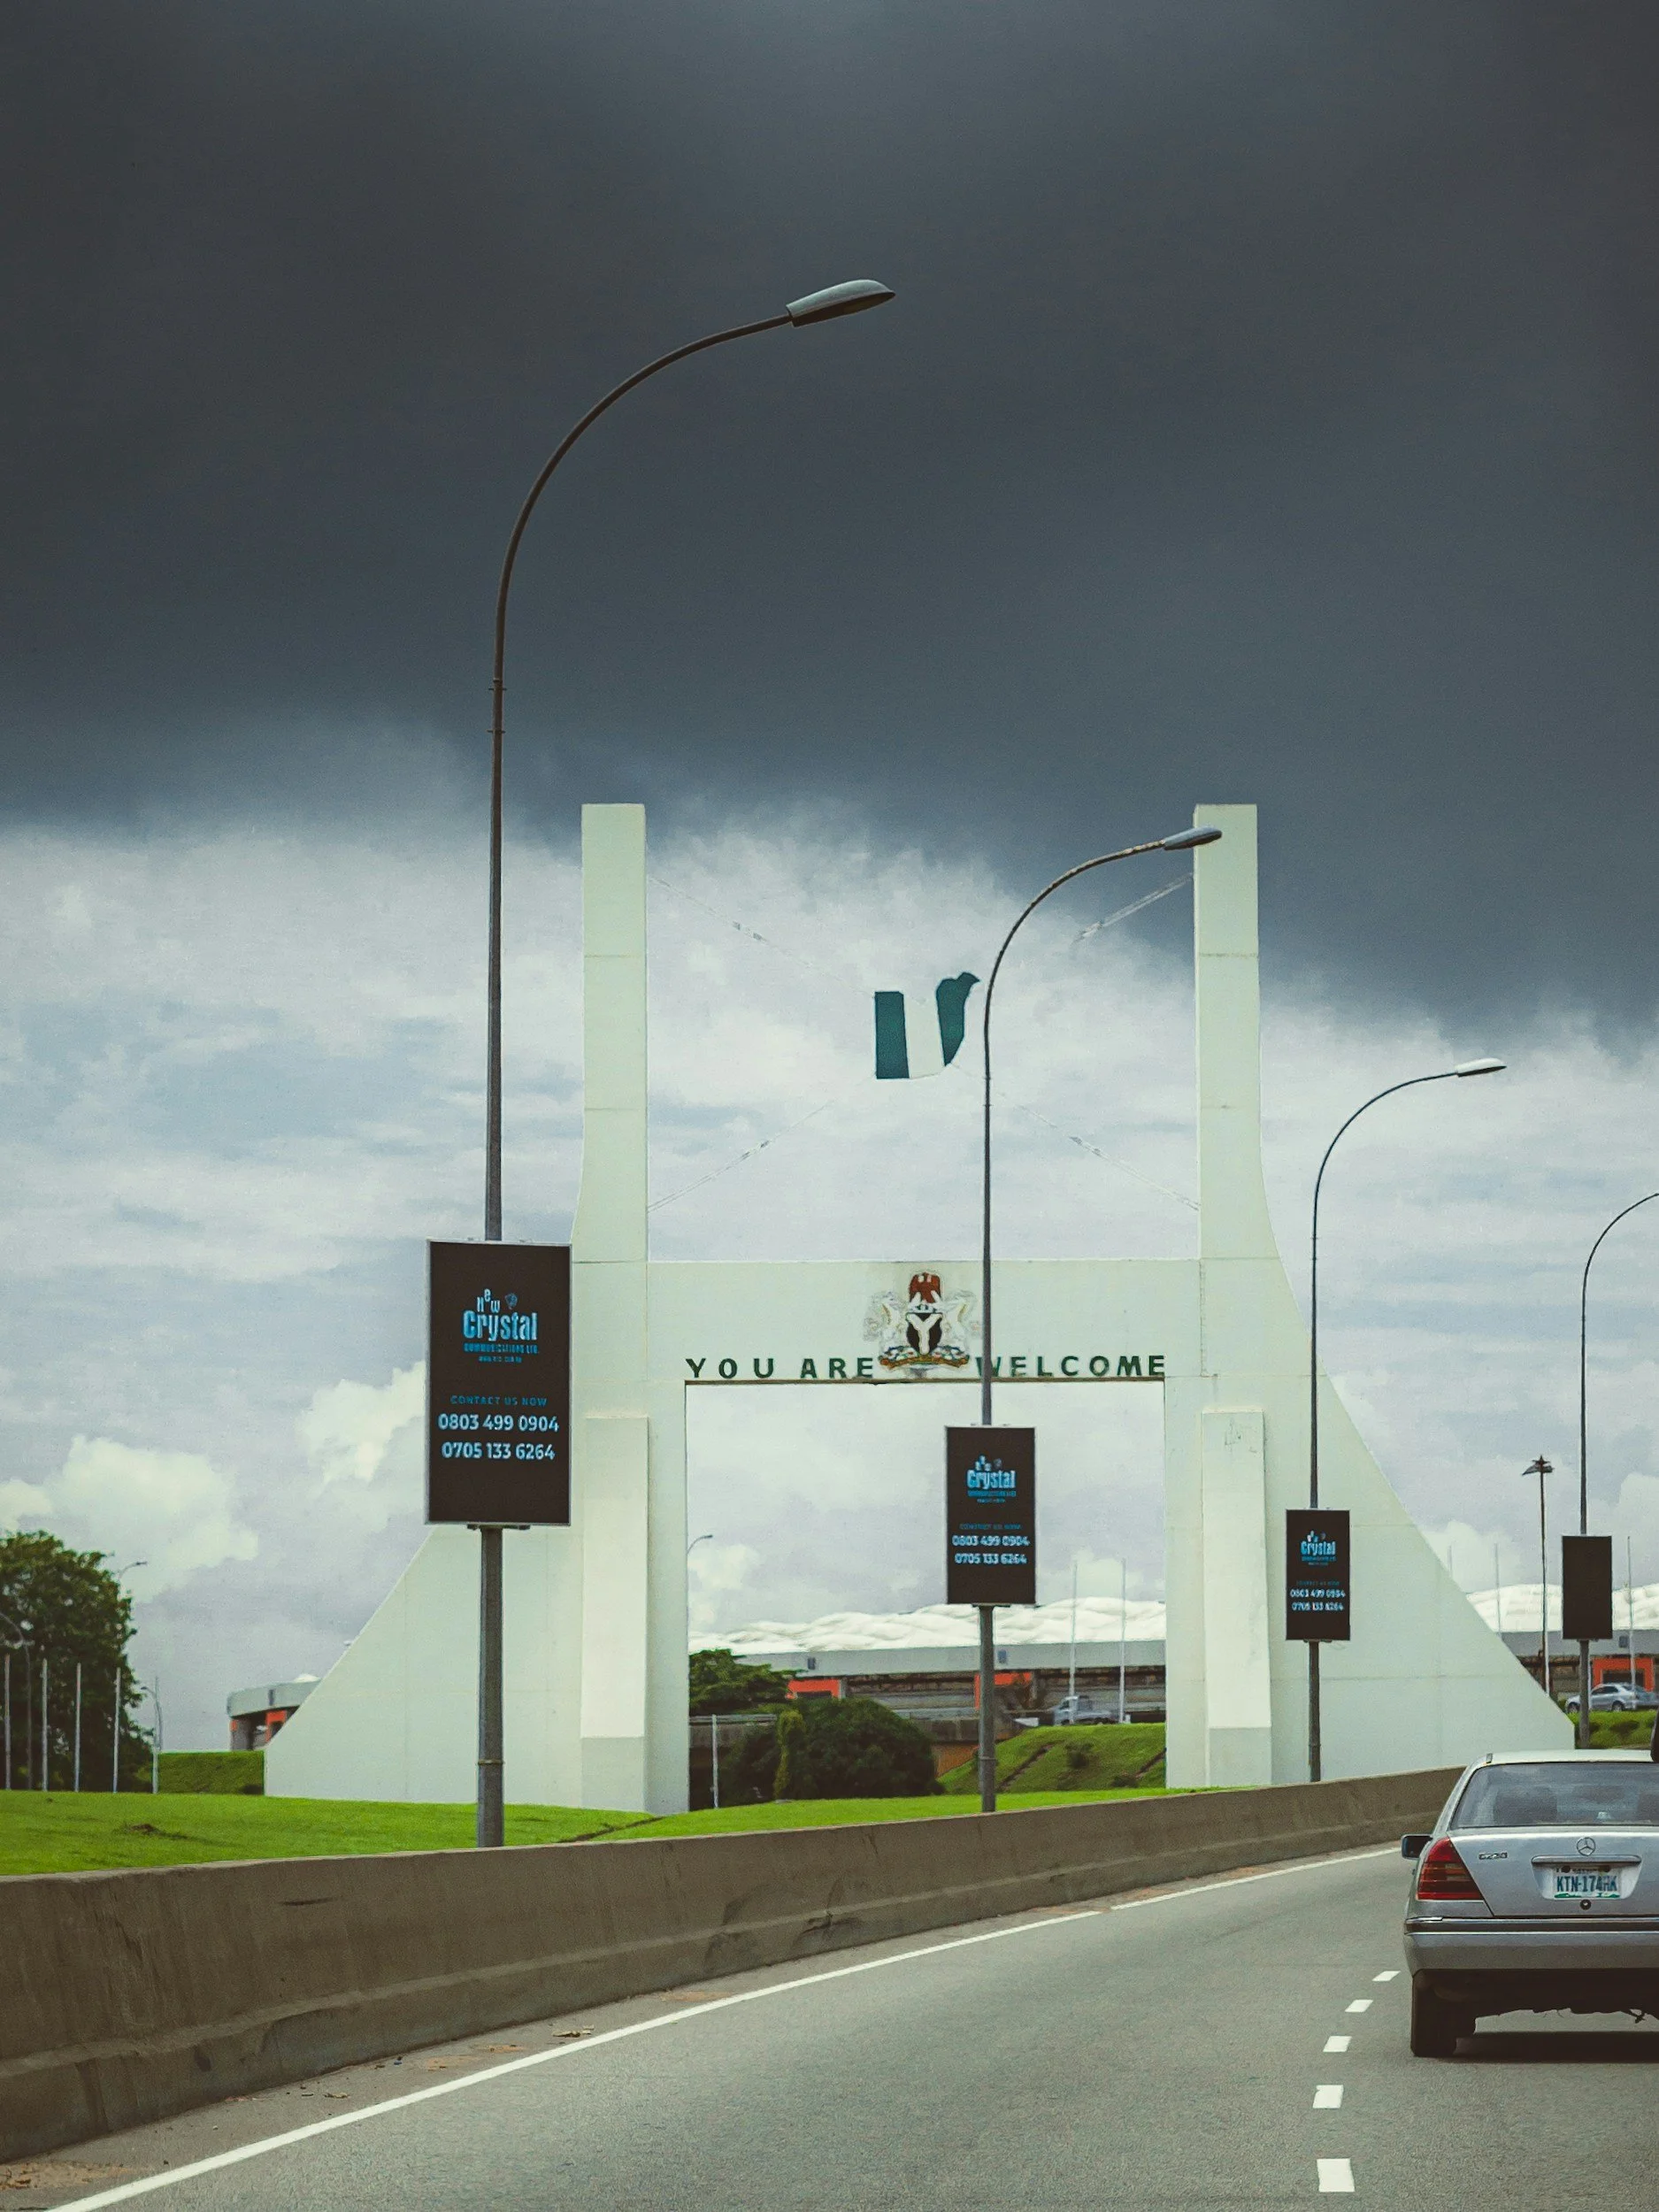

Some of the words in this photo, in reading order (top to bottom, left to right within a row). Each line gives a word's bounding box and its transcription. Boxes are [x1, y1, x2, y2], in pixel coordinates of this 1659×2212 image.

[463, 1310, 538, 1342] Crystal
[685, 1357, 774, 1379] YOU
[800, 1356, 873, 1379] ARE
[975, 1355, 1164, 1378] WELCOME
[449, 1394, 500, 1405] CONTACT
[503, 1396, 518, 1406] US
[521, 1396, 548, 1407] NOW
[437, 1413, 480, 1431] 0803
[481, 1413, 514, 1432] 499
[517, 1415, 559, 1432] 0904
[441, 1441, 483, 1459] 0705
[485, 1442, 511, 1459] 133
[515, 1442, 556, 1460] 6264
[967, 1470, 1016, 1490] Crystal
